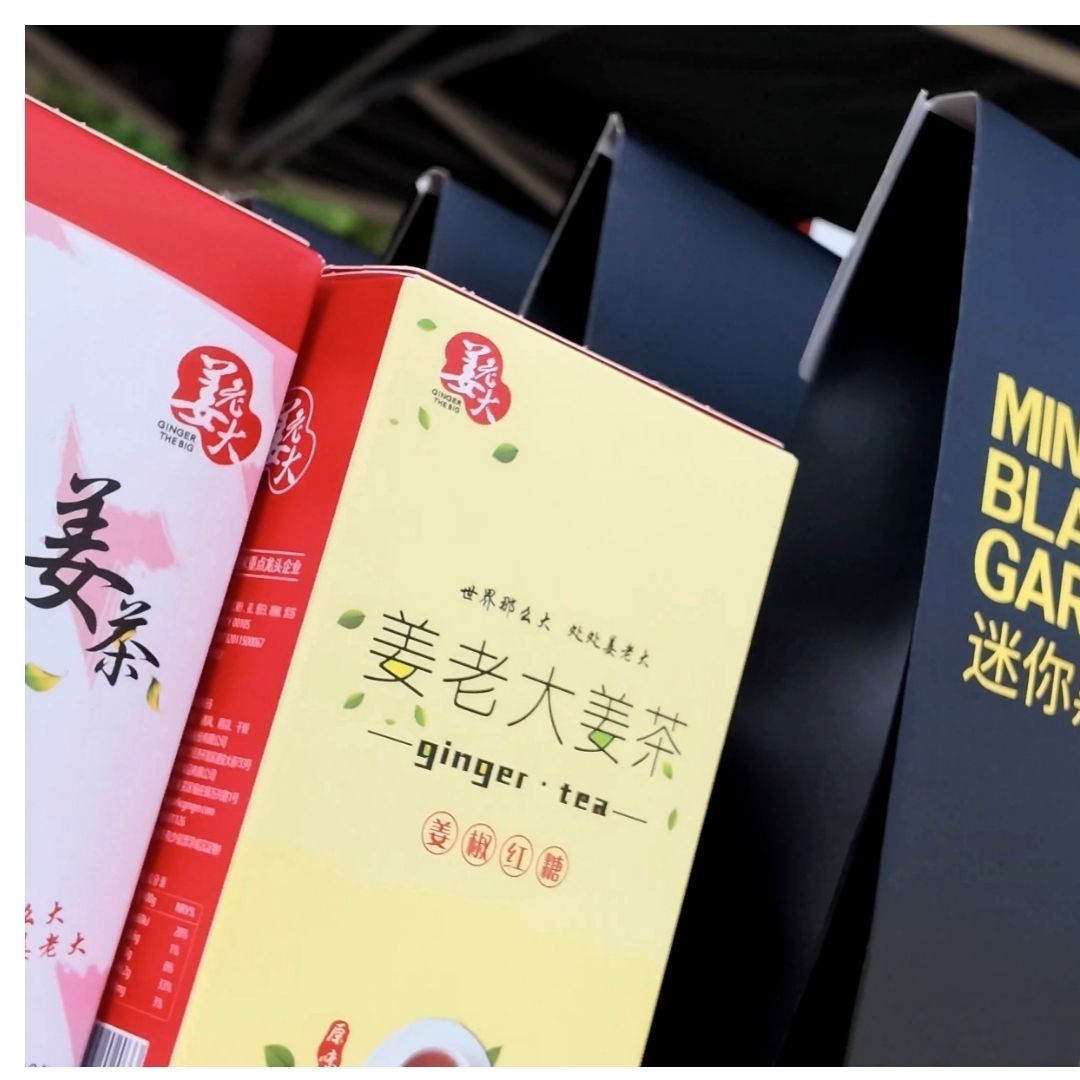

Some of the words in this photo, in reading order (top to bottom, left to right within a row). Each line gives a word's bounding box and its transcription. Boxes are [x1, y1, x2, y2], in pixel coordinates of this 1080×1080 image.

[431, 389, 462, 406] GINGER
[157, 420, 197, 443] GINGER
[160, 431, 177, 445] THE
[178, 438, 195, 453] BIG
[460, 585, 550, 631] 世界那么大
[363, 610, 687, 777] 姜老大姜茶
[414, 740, 528, 789] ginger
[558, 783, 609, 817] tea
